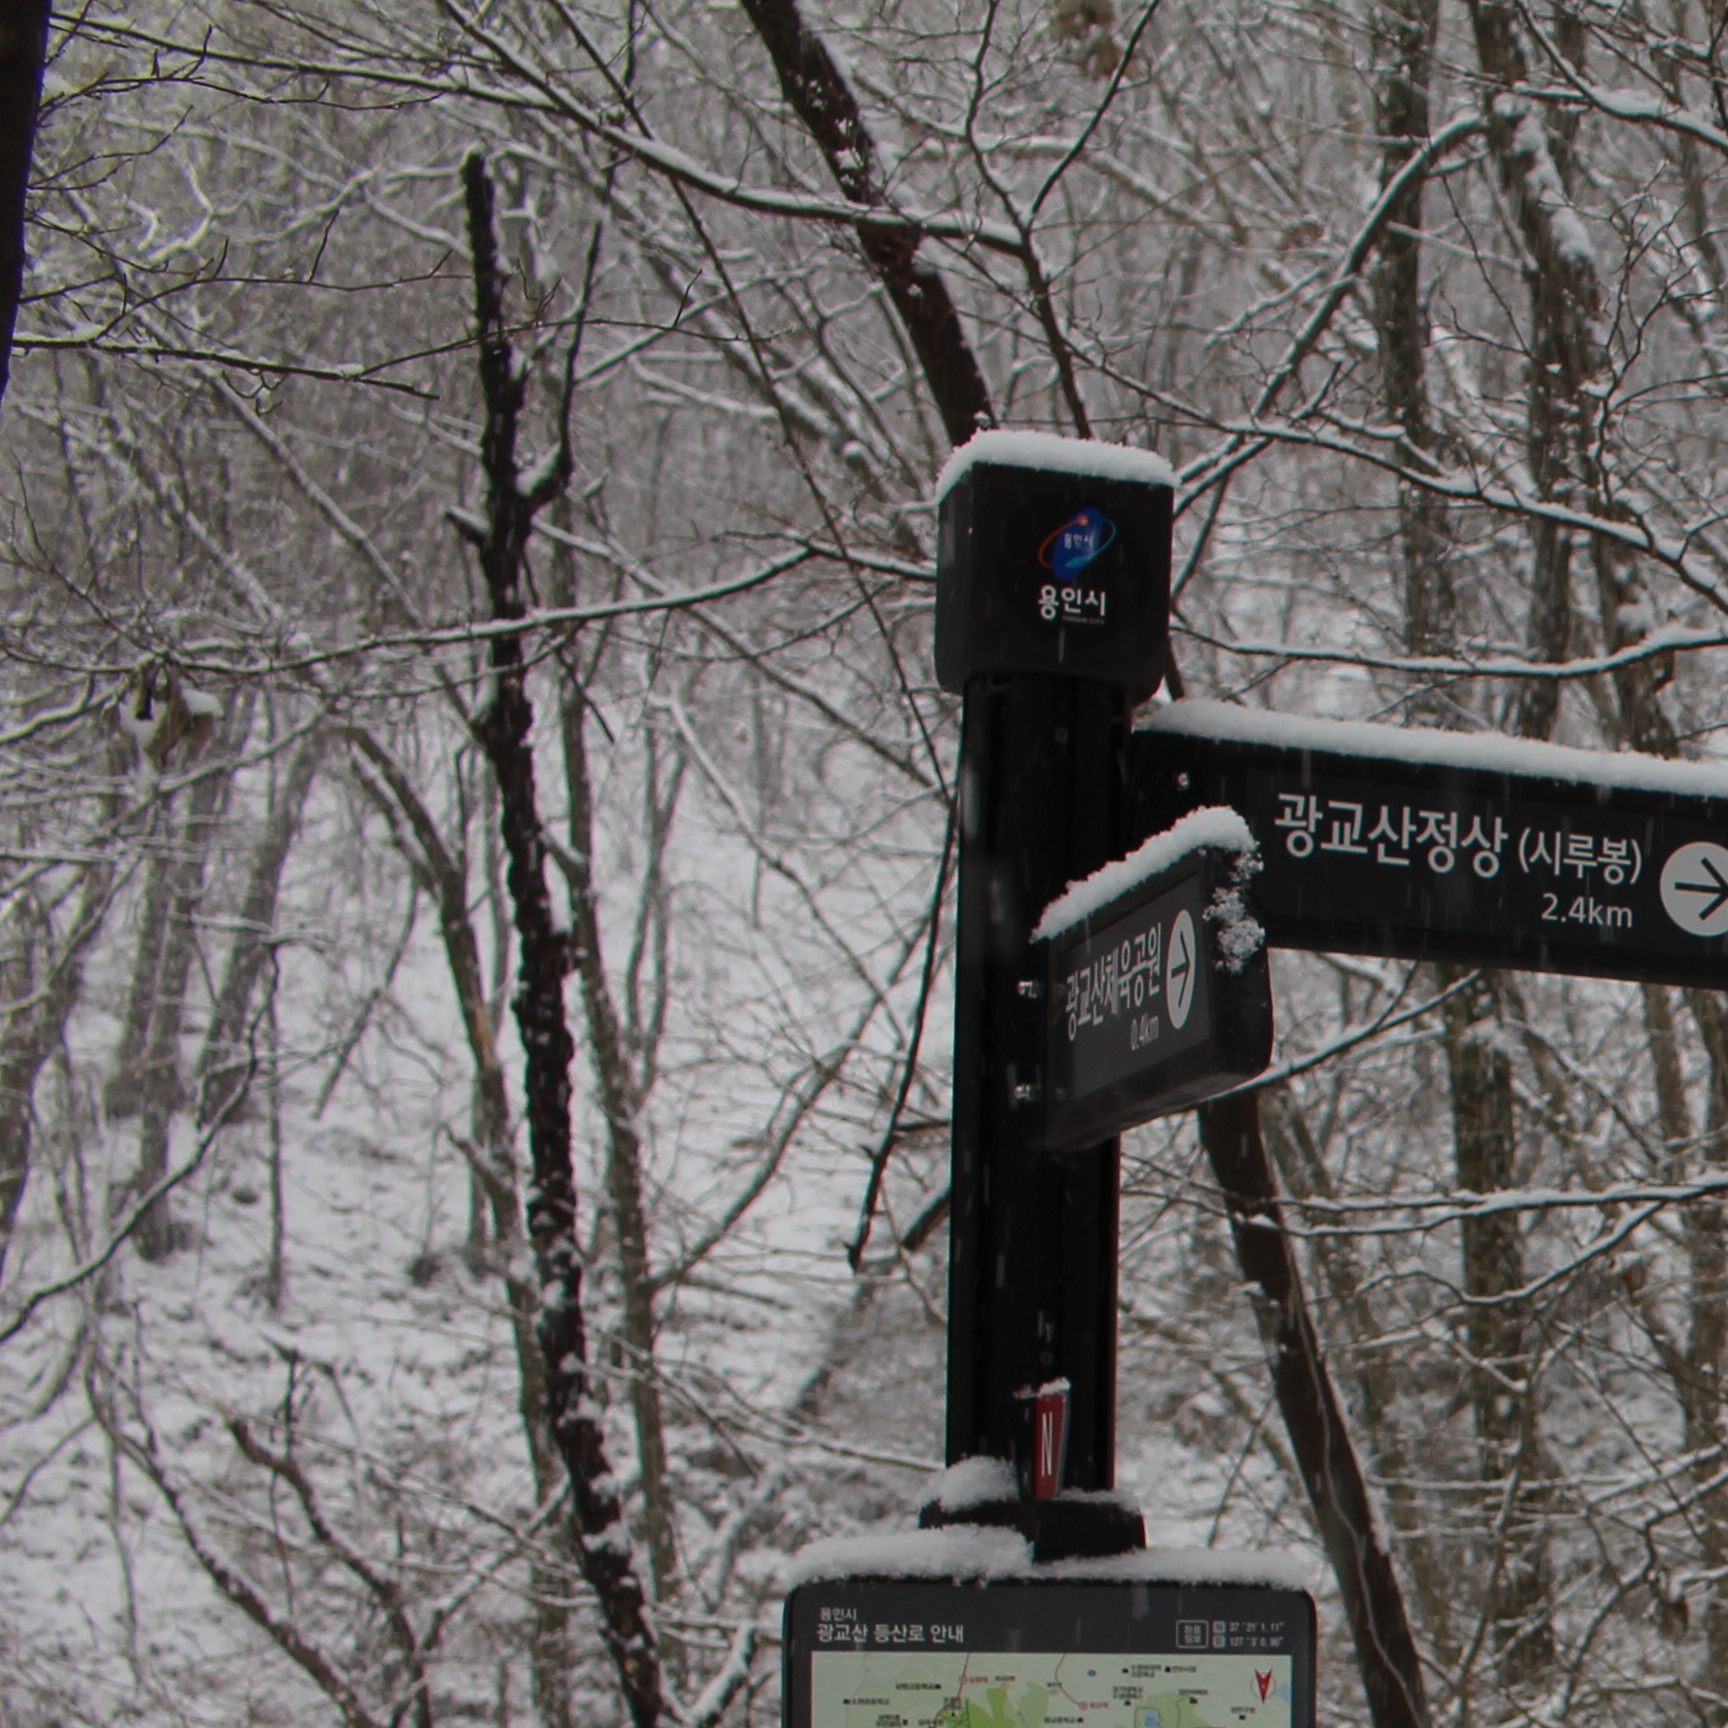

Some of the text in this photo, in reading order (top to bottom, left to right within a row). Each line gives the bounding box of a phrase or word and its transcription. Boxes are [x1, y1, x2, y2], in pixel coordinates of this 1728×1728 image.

[1038, 584, 1107, 620] 용인시
[1274, 792, 1642, 886] 광교산정상 (시루봉)
[1541, 893, 1634, 930] 2.4km
[1065, 922, 1162, 1042] 광교산체육공원
[1131, 1015, 1159, 1051] 0.4km
[820, 1606, 857, 1622] 용인시
[816, 1623, 964, 1644] 광교산 등산로 안내
